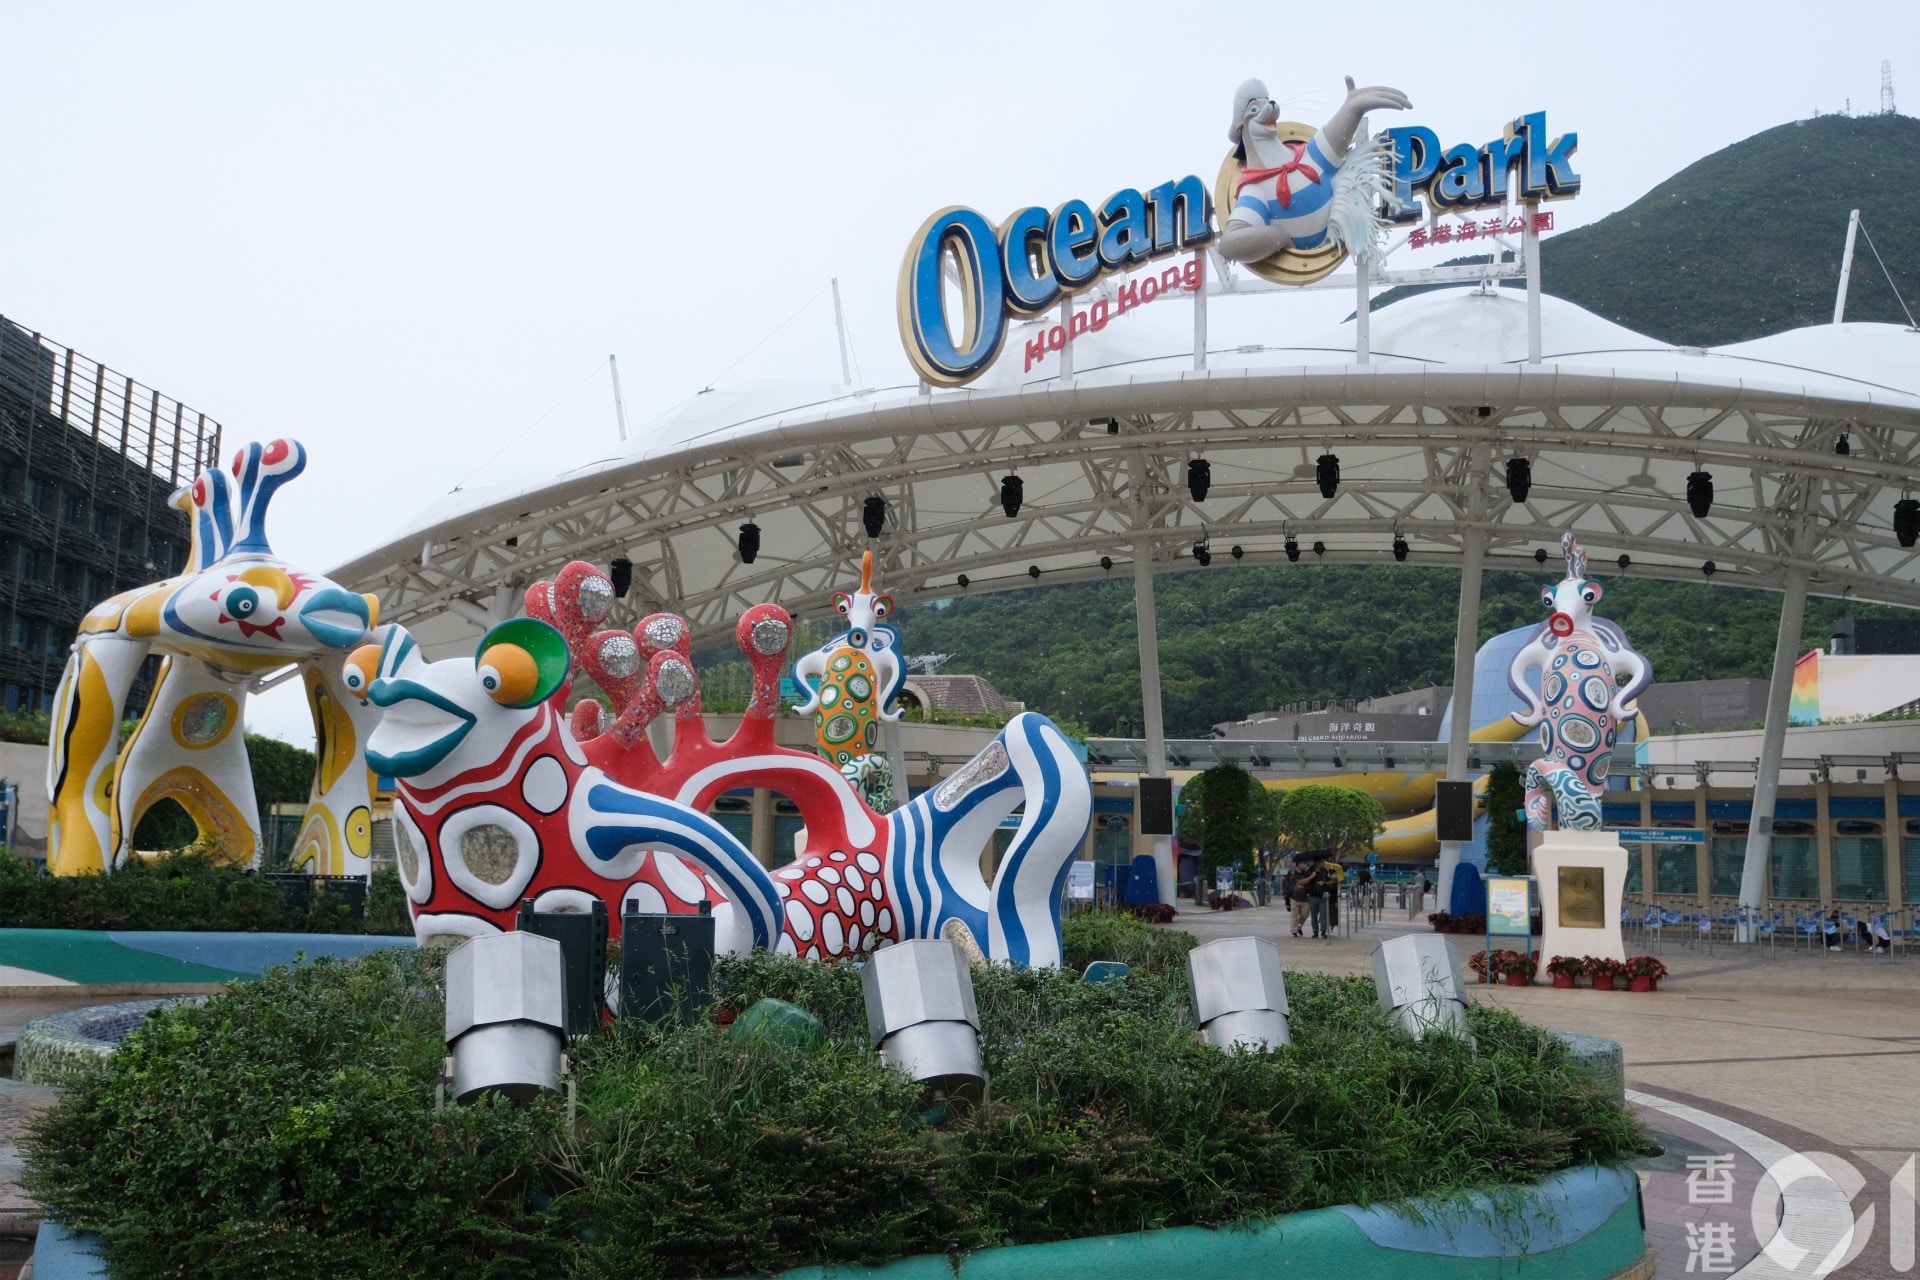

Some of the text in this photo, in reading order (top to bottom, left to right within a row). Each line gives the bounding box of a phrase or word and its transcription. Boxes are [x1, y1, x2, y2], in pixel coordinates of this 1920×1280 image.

[897, 110, 1581, 388] Ocean Park
[1408, 212, 1554, 250] 香港海洋公園
[1024, 258, 1203, 373] Hong Kong
[1328, 722, 1376, 733] 海洋奇觀
